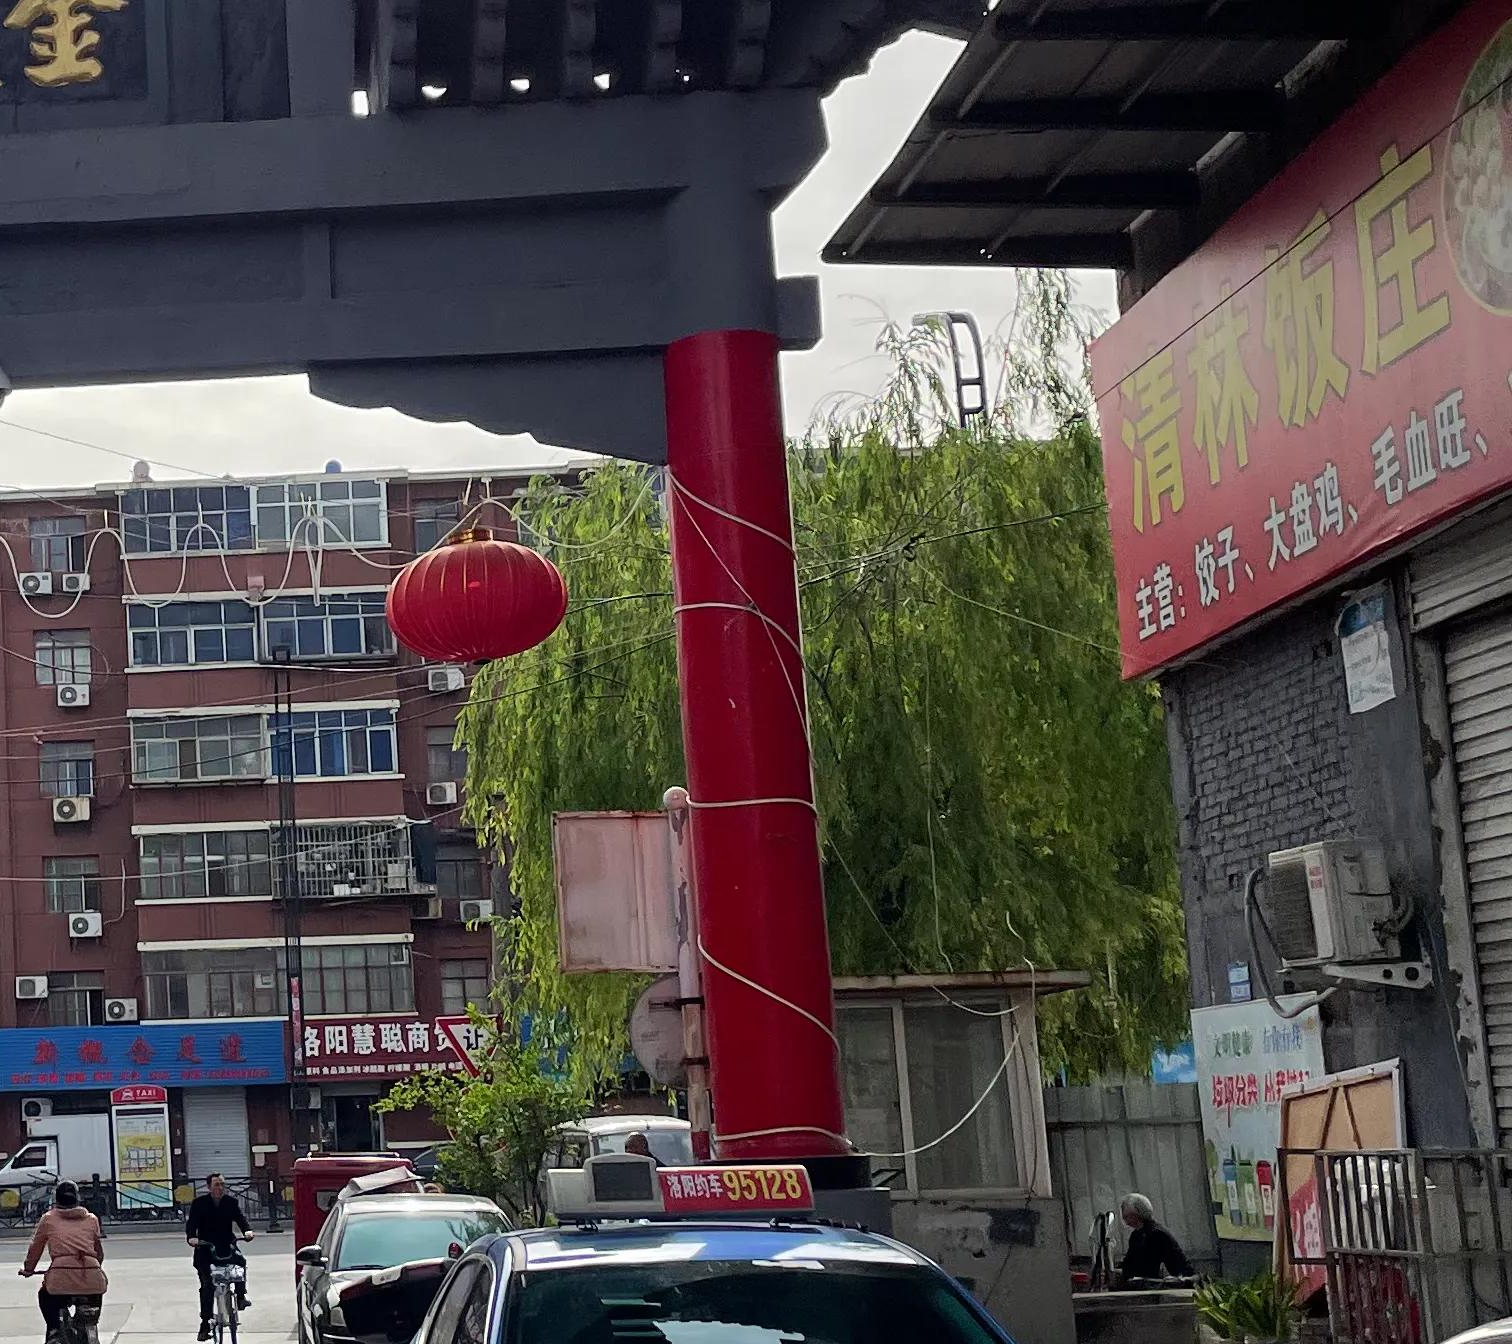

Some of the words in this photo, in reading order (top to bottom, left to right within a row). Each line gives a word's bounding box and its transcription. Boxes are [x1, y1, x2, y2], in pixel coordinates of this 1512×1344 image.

[136, 1089, 156, 1097] TAXI
[1212, 1072, 1258, 1108] 垃圾分类
[666, 1173, 724, 1200] 洛阳约车
[722, 1168, 802, 1202] 95128
